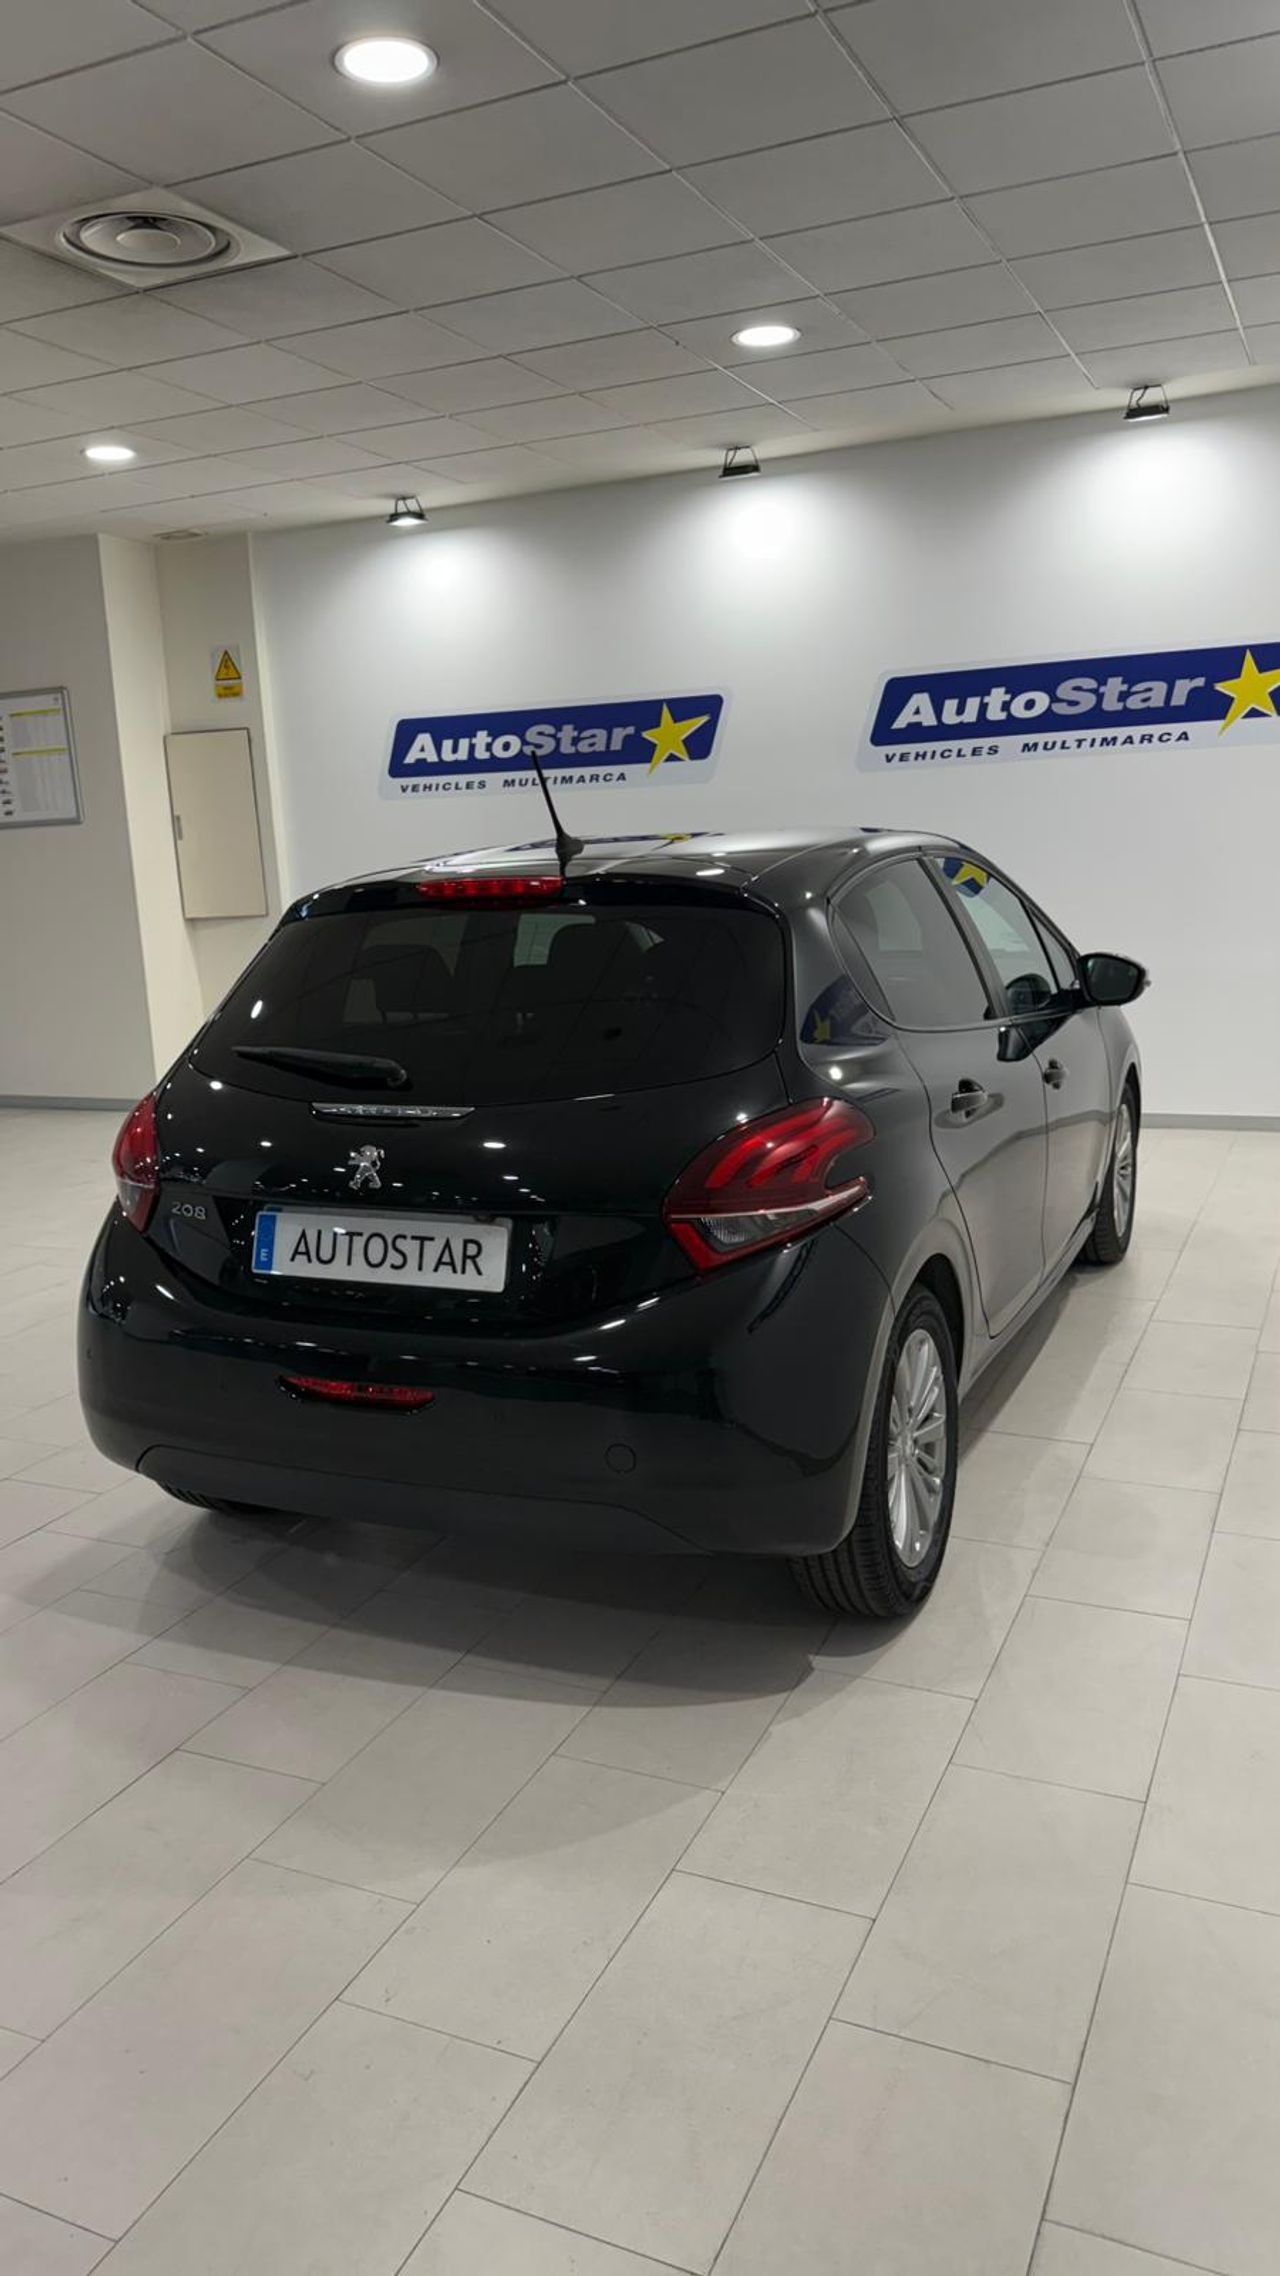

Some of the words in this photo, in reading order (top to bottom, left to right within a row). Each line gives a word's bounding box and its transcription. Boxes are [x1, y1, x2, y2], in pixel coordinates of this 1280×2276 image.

[891, 676, 1204, 731] AutoStar
[404, 724, 635, 764] AutoStar
[886, 745, 1000, 764] VEHICLES
[1021, 732, 1190, 753] MULTIMARCA
[401, 780, 487, 794] VEHICLES
[171, 1201, 206, 1220] 208
[260, 1249, 268, 1261] E
[290, 1229, 483, 1276] AUTOSTAR
